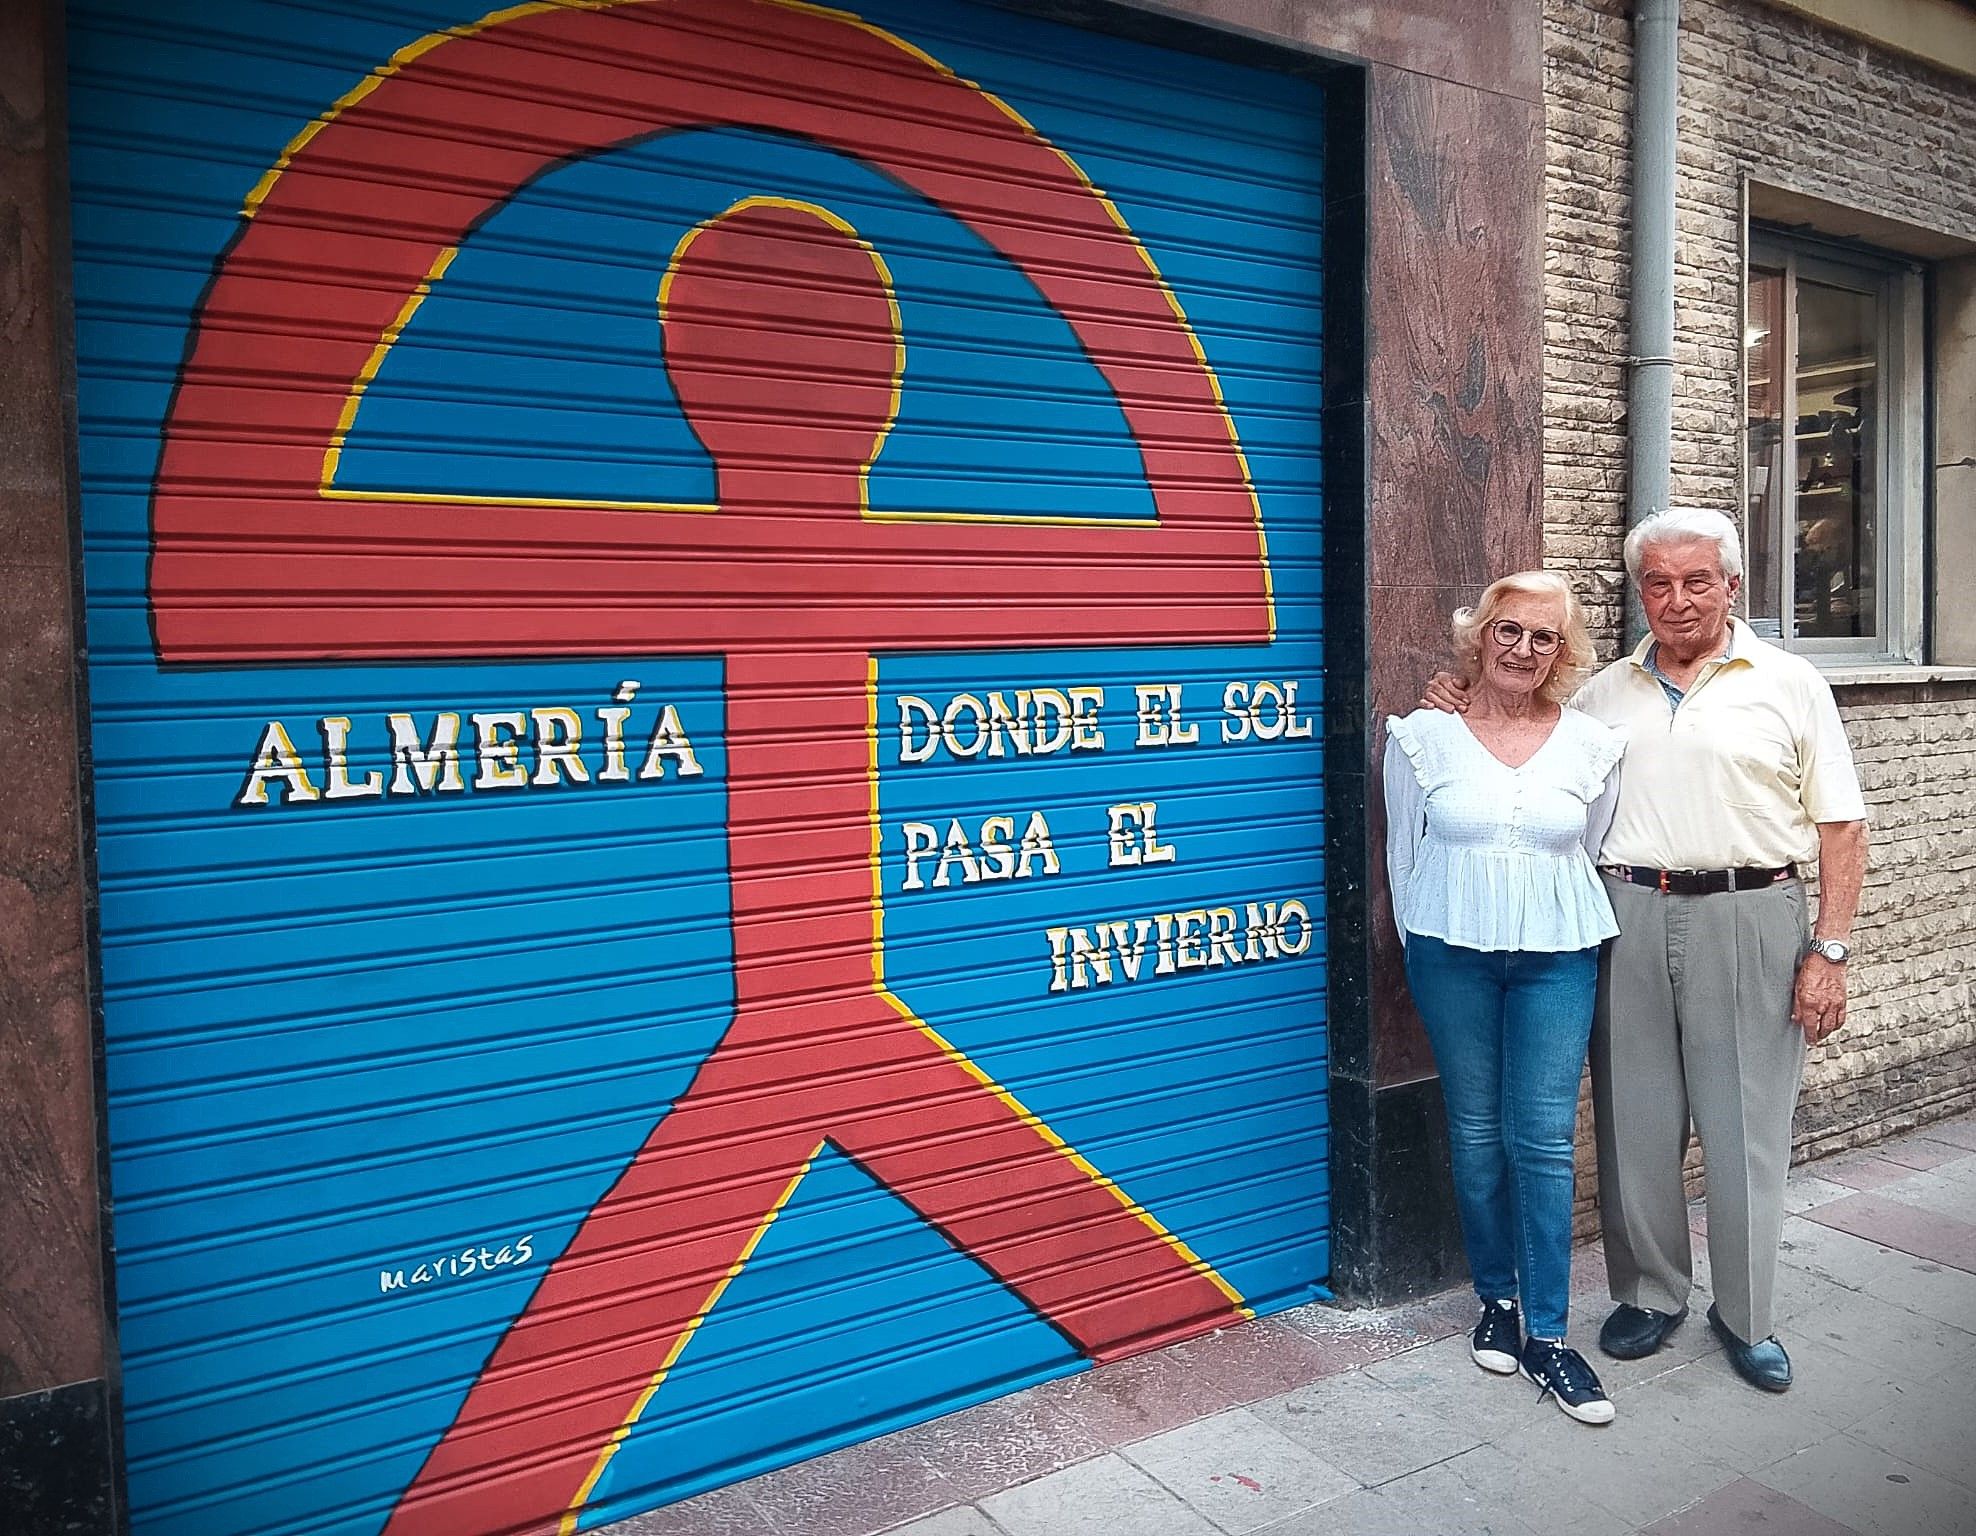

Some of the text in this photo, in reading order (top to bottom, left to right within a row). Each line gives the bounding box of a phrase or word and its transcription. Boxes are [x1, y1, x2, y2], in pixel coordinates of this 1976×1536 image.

[237, 680, 704, 806] ALMERÍA
[897, 680, 1313, 763] DONDE EL SOL
[902, 801, 1176, 891] PASA EL
[1045, 899, 1313, 993] INVIERNO
